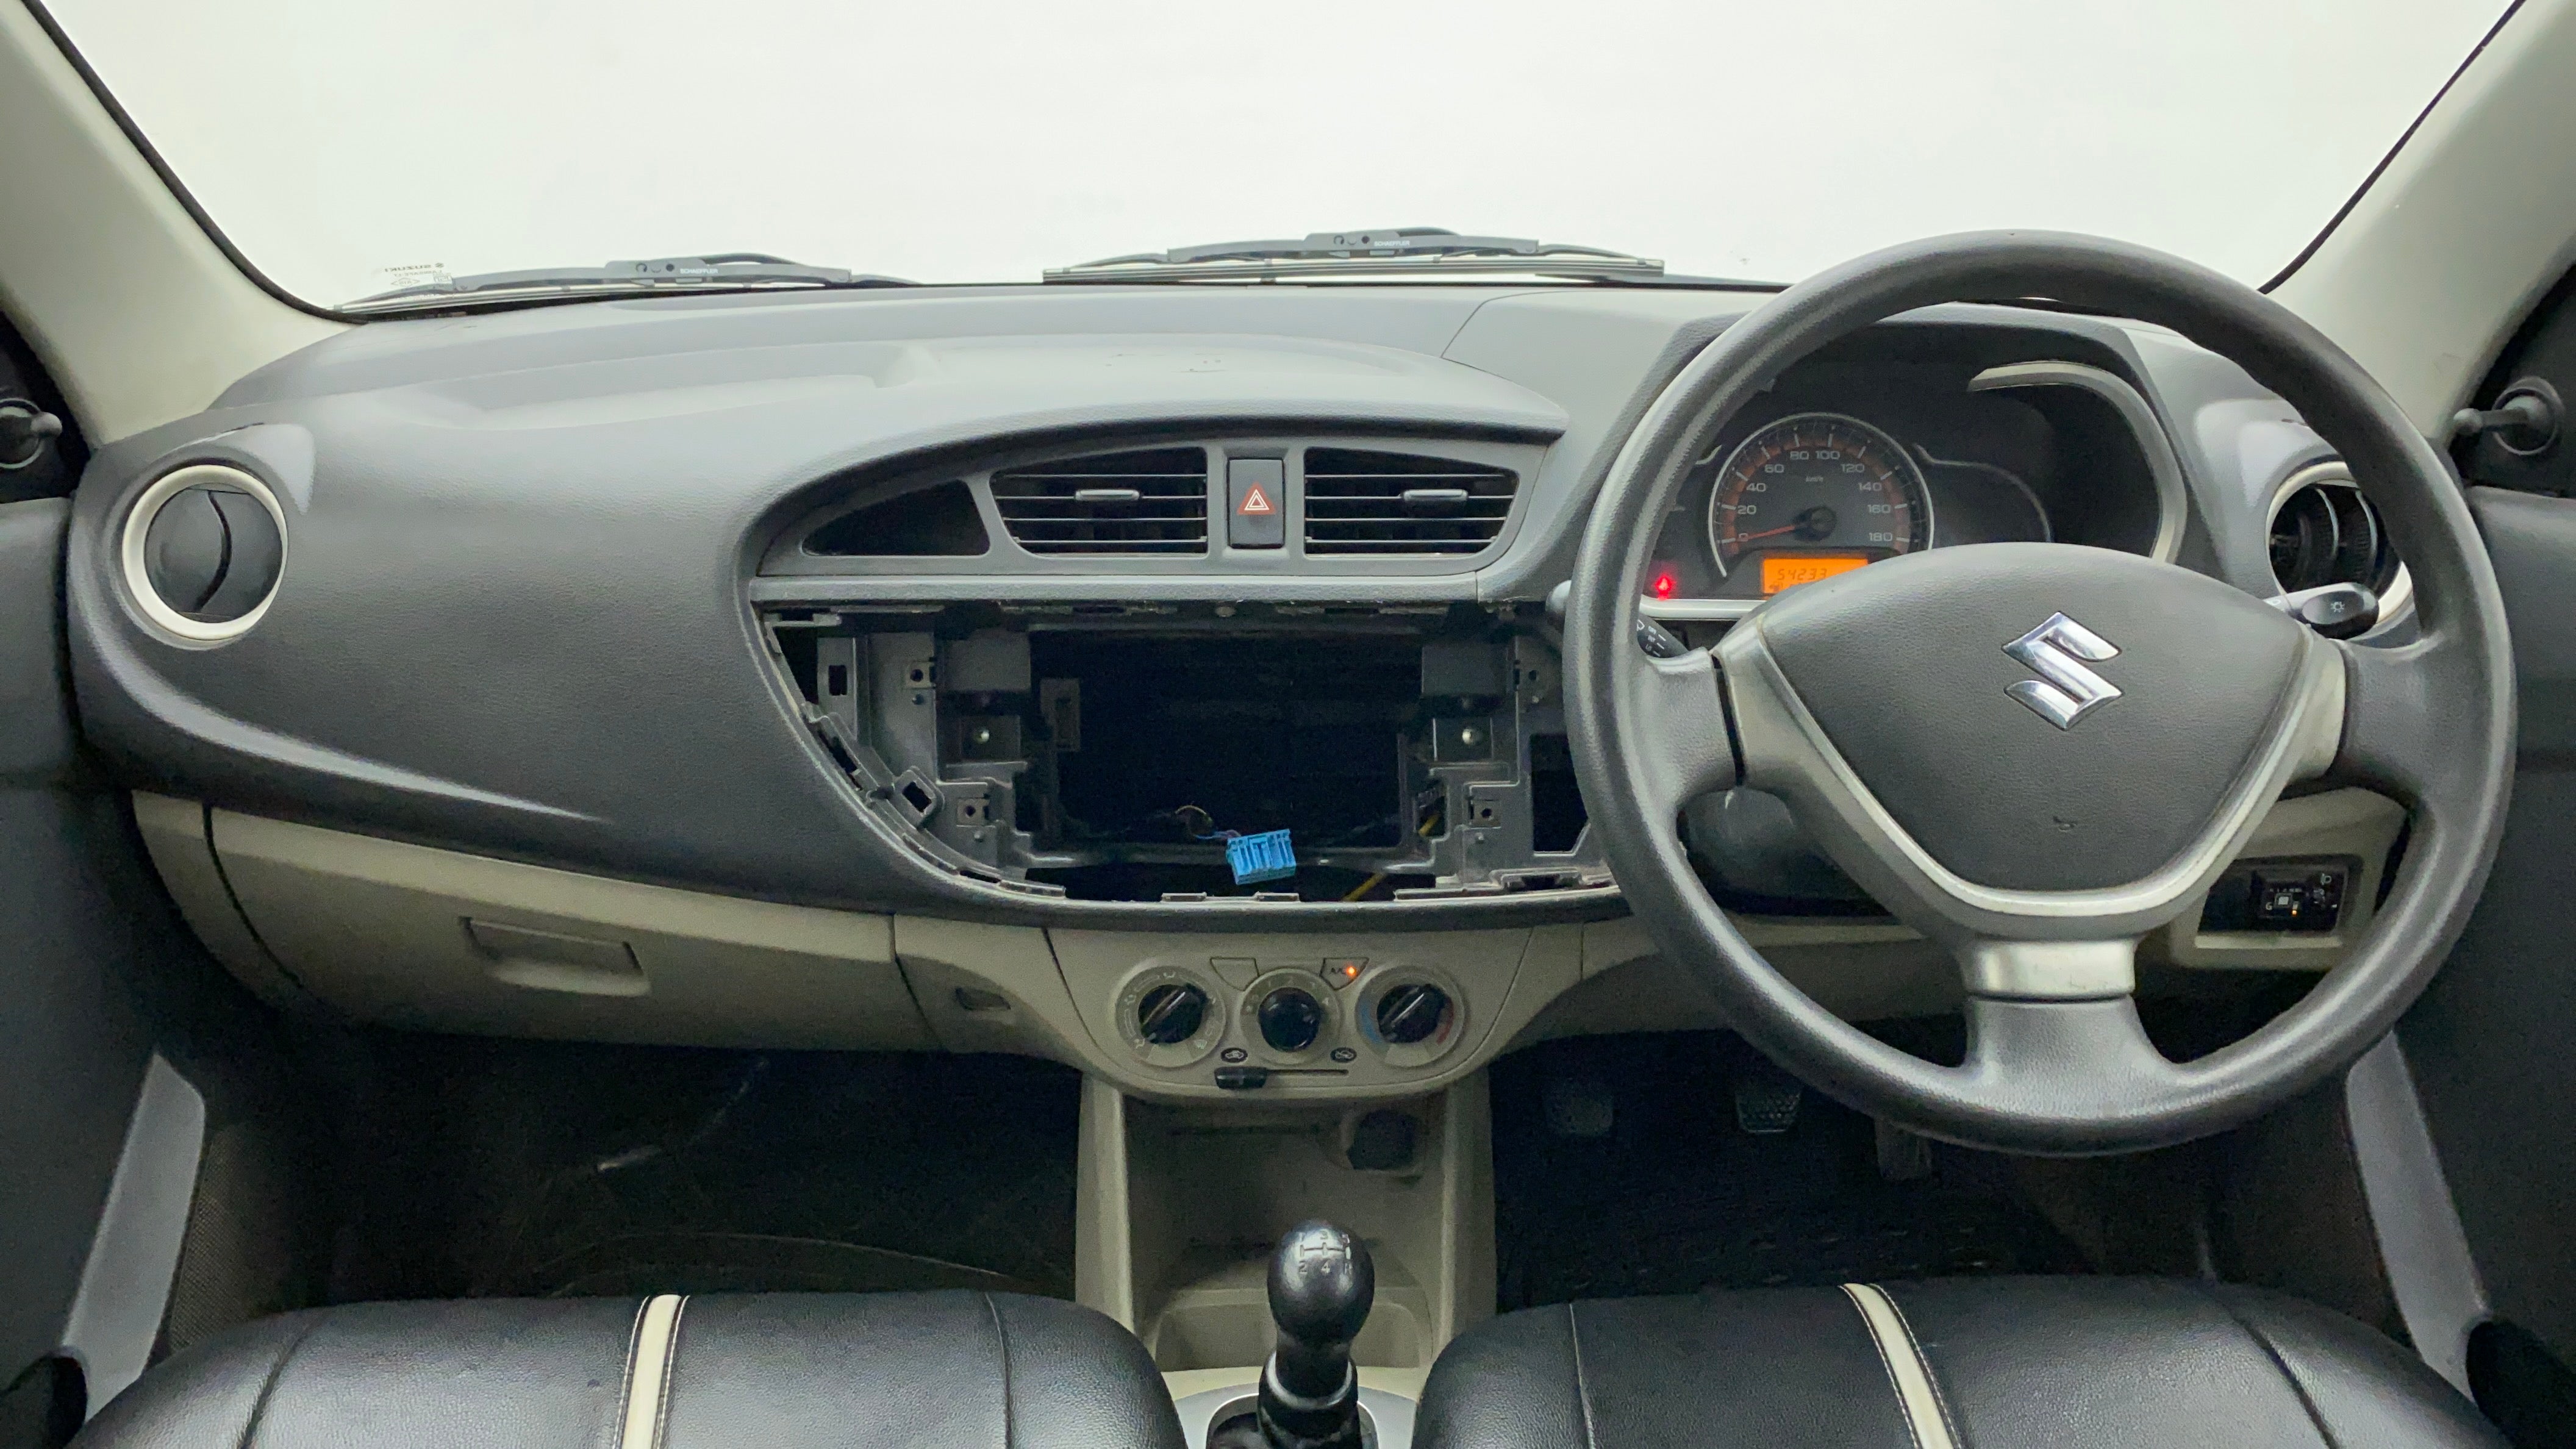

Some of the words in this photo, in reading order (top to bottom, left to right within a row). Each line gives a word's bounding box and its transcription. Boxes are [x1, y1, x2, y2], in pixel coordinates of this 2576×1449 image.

[1790, 451, 1809, 460] 80
[1815, 451, 1841, 460] 100
[1764, 464, 1784, 473] 60
[1841, 463, 1865, 473] 120
[1746, 482, 1766, 492] 40
[1858, 482, 1882, 492] 140
[1737, 505, 1756, 515] 20
[1867, 504, 1891, 513] 160
[1739, 532, 1748, 542] 0
[1869, 532, 1892, 542] 180
[1777, 568, 1828, 581] 54233
[1320, 1229, 1329, 1240] 3
[1299, 1260, 1308, 1274] 2
[1321, 1259, 1331, 1274] 4
